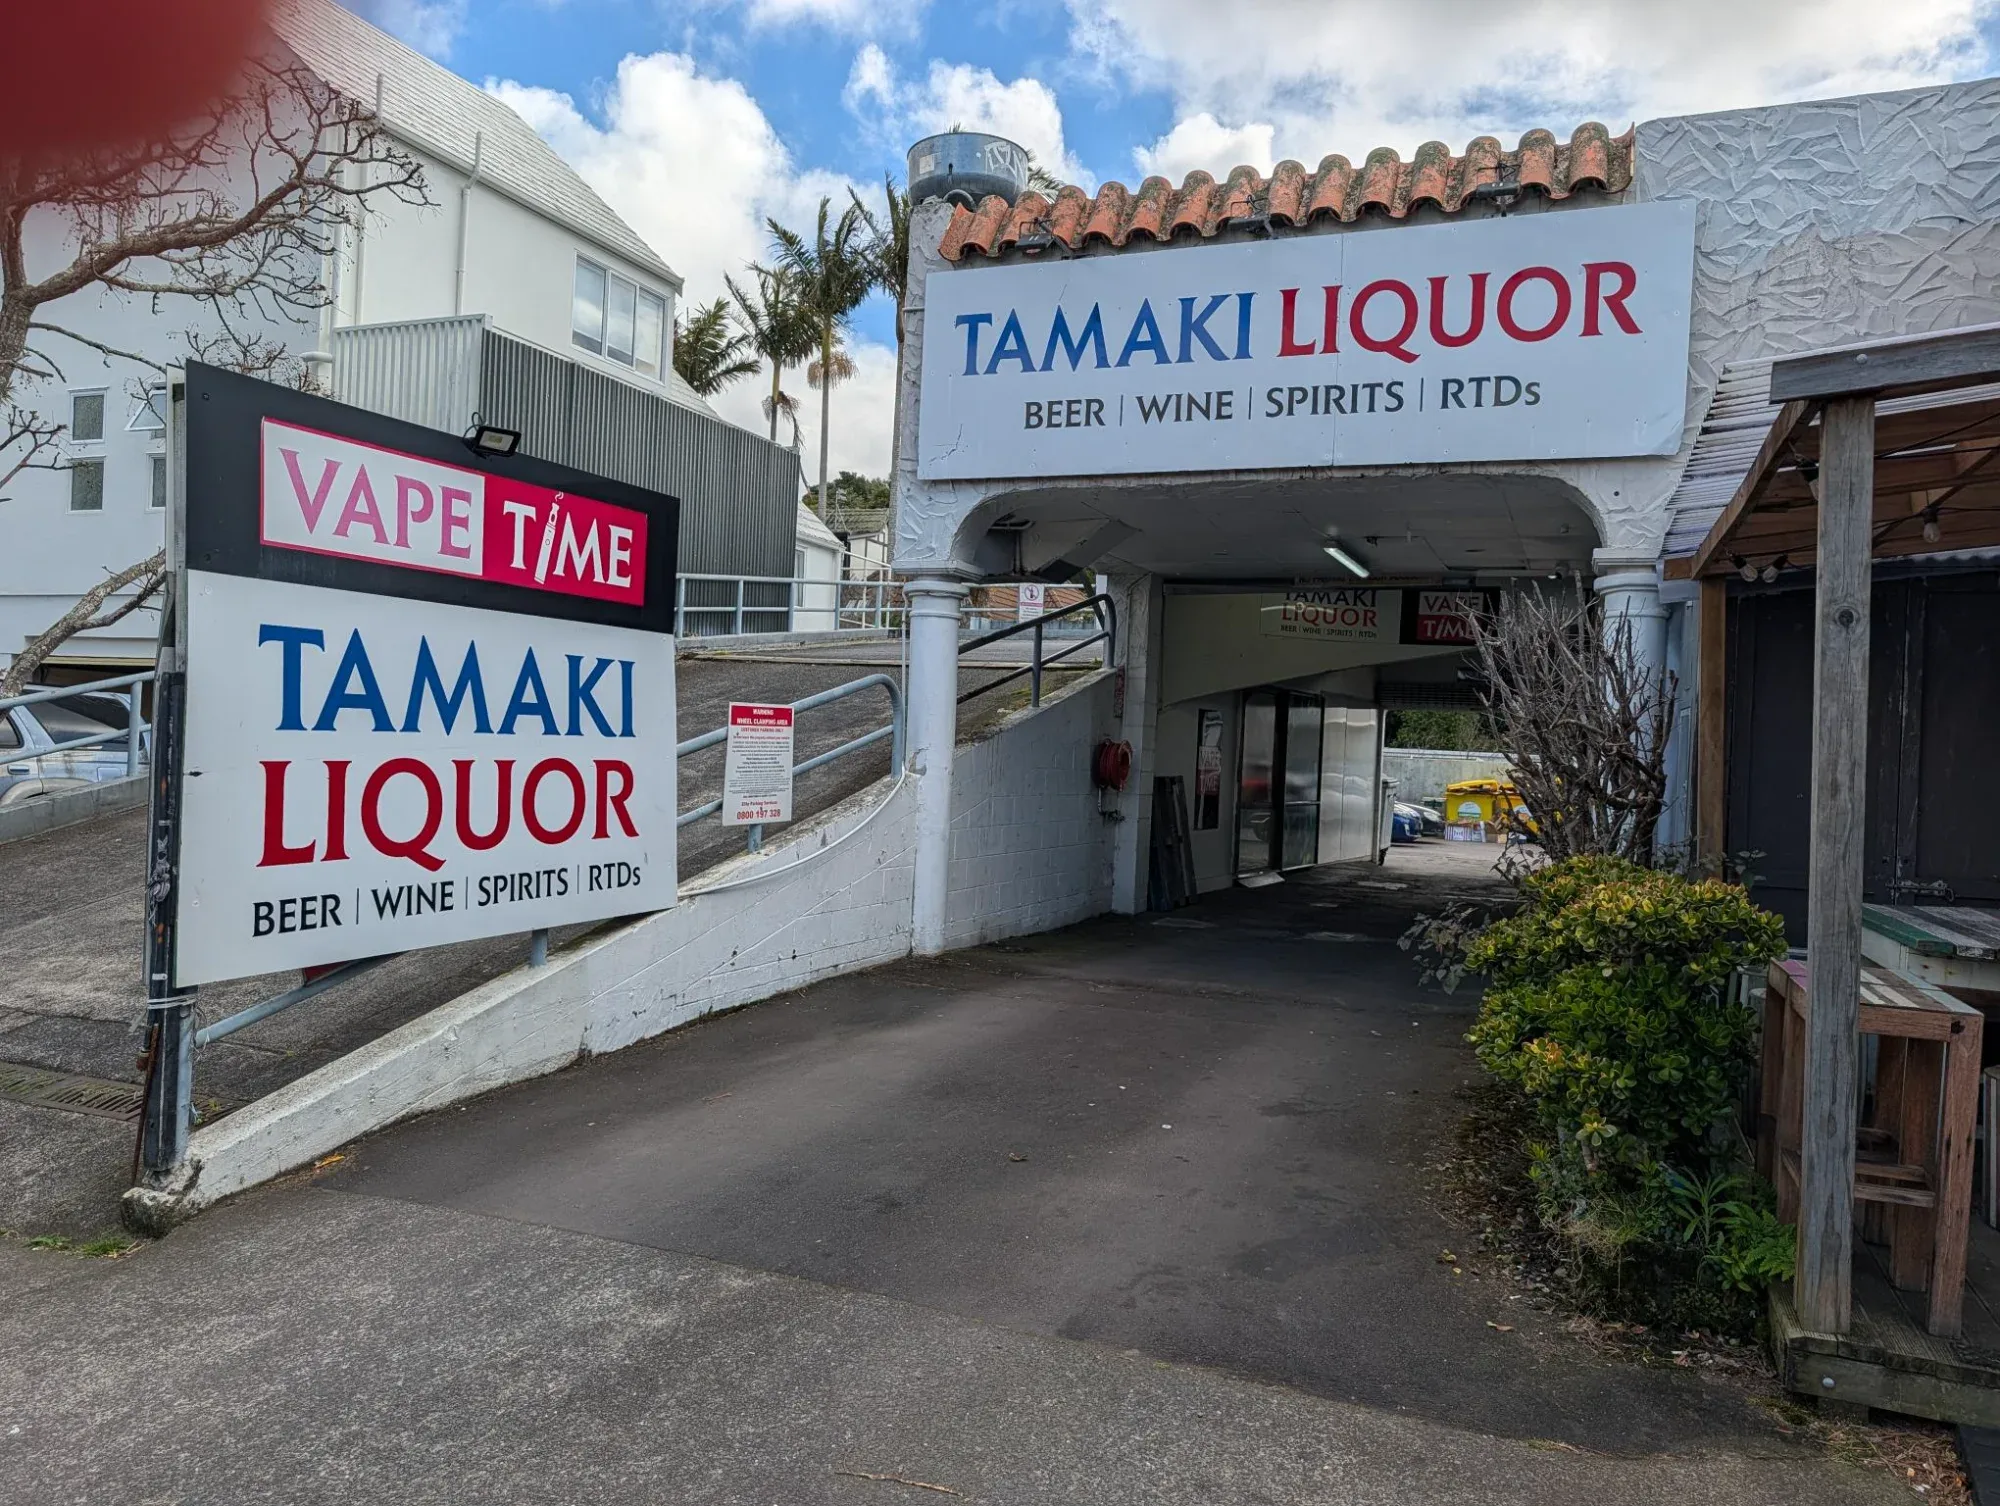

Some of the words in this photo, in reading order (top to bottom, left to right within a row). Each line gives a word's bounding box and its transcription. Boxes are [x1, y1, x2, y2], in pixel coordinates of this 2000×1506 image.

[954, 291, 1257, 377] TAMAKI
[1279, 260, 1643, 364] LIQUOR
[1023, 397, 1105, 431] BEER
[1136, 389, 1234, 424] WINE
[1265, 379, 1404, 419] SPIRITS
[1440, 374, 1542, 411] RTDs
[278, 447, 472, 559] VAPE
[503, 496, 633, 588] TIME
[1281, 603, 1378, 627] LIQUOR
[1423, 595, 1479, 613] VAPE
[1280, 625, 1298, 633] BEER
[1302, 627, 1321, 635] WINE
[1326, 629, 1353, 637] SPIRITS
[258, 624, 636, 738] TAMAKI
[736, 717, 753, 725] WHEEL
[753, 718, 777, 726] CLAMPING
[752, 708, 774, 716] WARNING
[256, 757, 640, 872] LIQUOR
[737, 810, 754, 820] 0800
[756, 809, 768, 819] 197
[252, 892, 343, 938] BEER
[371, 880, 455, 920] WINE
[477, 867, 569, 907] SPIRITS
[588, 863, 641, 892] RTDs
